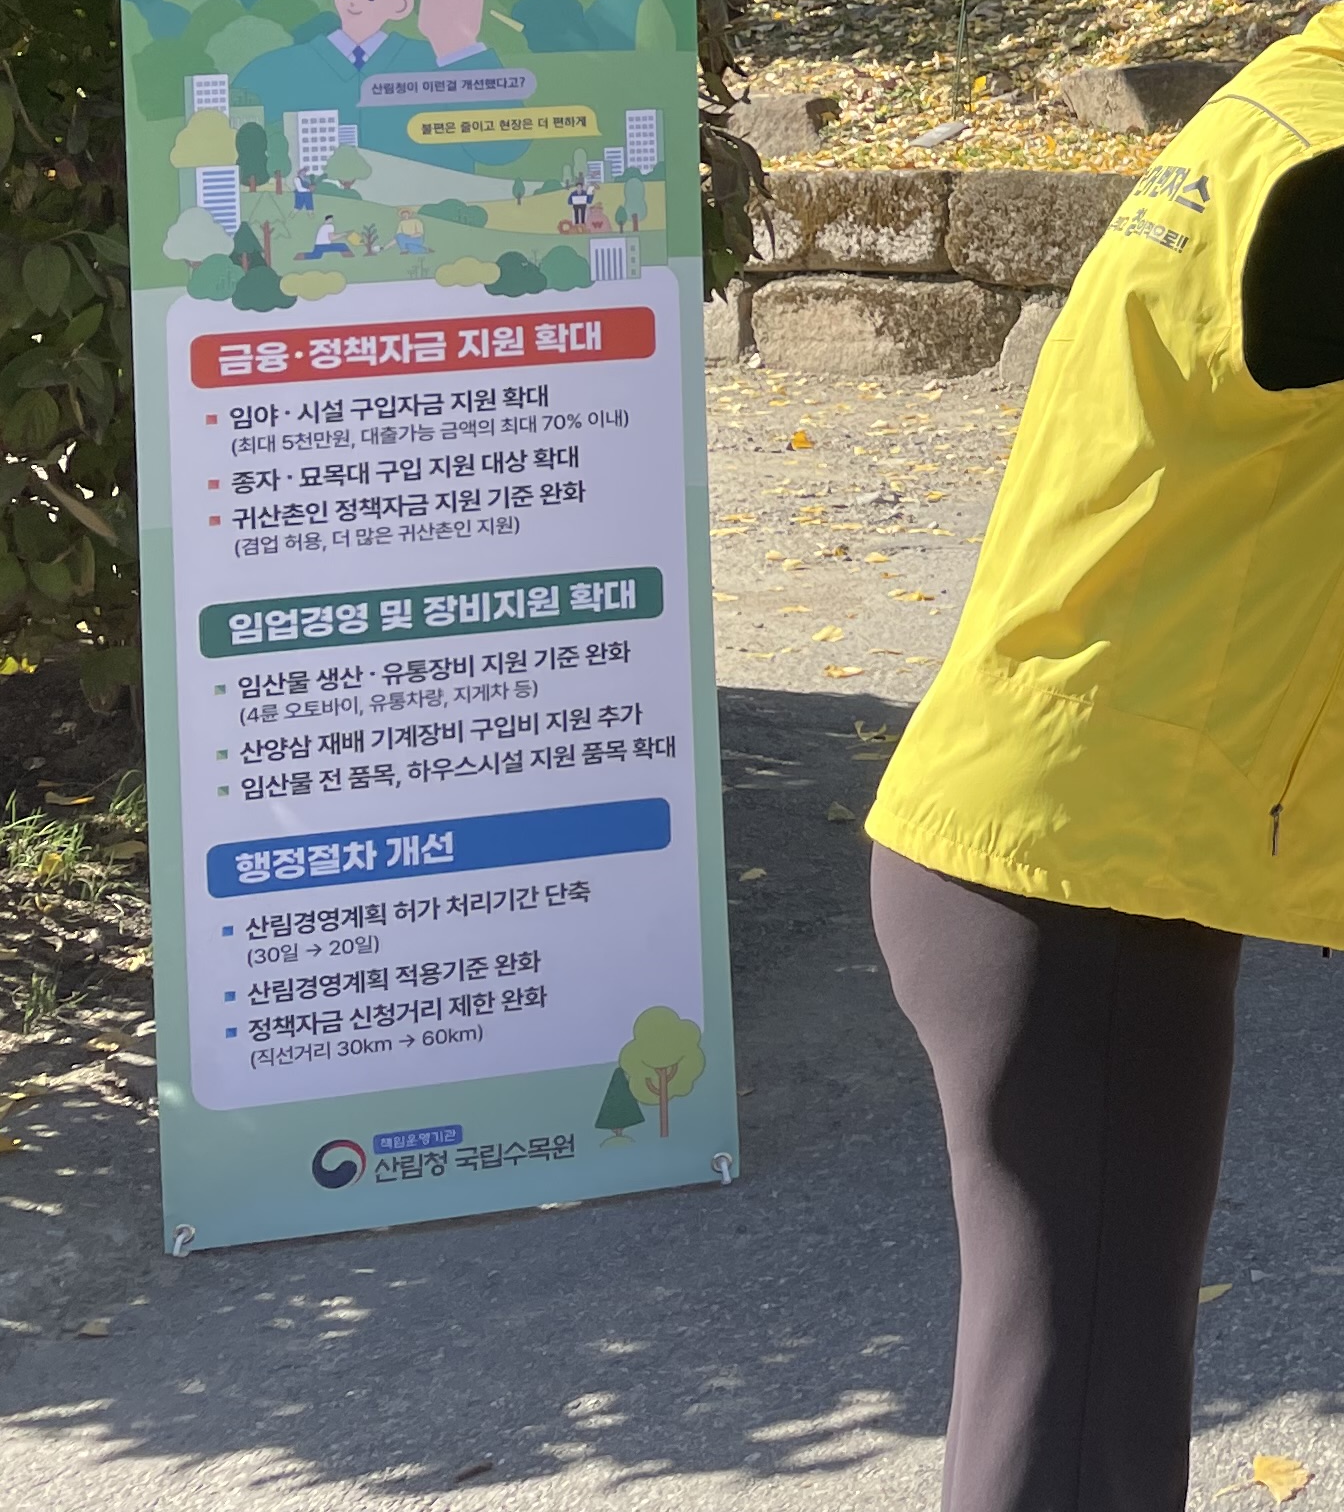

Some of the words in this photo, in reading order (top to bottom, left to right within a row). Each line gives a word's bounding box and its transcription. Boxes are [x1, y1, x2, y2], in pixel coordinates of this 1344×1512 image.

[498, 117, 534, 132] 현장은
[537, 116, 549, 130] 더
[552, 115, 587, 129] 편하게
[458, 326, 524, 358] 지원
[535, 321, 601, 353] 확대
[230, 404, 279, 430] 임야
[297, 399, 344, 424] 시설
[350, 393, 445, 421] 구입자금
[451, 388, 496, 413] 지원
[503, 384, 548, 409] 확대
[232, 434, 276, 457] (최대
[282, 429, 355, 450] 5천만원,
[361, 424, 435, 445] 대출가능
[440, 418, 495, 440] 금액의
[501, 415, 537, 435] 최대
[542, 413, 582, 431] 70%
[588, 409, 629, 428] 이내)
[231, 468, 281, 494] 종자
[299, 462, 369, 487] 묘목대
[376, 457, 421, 483] 구입
[429, 453, 475, 478] 지원
[482, 449, 528, 474] 대상
[533, 445, 579, 470] 확대
[232, 500, 328, 530] 귀산촌인
[335, 494, 429, 522] 정책자금
[435, 489, 481, 513] 지원
[488, 485, 534, 509] 기준
[540, 480, 586, 505] 완화
[235, 535, 278, 558] (겸업
[284, 532, 327, 552] 허용,
[332, 529, 350, 548] 더
[356, 526, 393, 546] 많은
[398, 519, 471, 542] 귀산촌인
[477, 516, 520, 536] 지원)
[229, 603, 368, 645] 임업경영
[380, 599, 412, 631] 및
[424, 586, 560, 626] 장비지원
[570, 579, 636, 612] 확대
[238, 671, 310, 699] 임산물
[316, 665, 364, 691] 생산
[382, 655, 474, 686] 유통장비
[482, 649, 527, 675] 지원
[535, 646, 580, 670] 기준
[585, 640, 631, 666] 완화
[284, 696, 363, 719] 오토바이,
[369, 688, 448, 713] 유통차량,
[454, 682, 510, 704] 지게차
[514, 680, 538, 698] 등)
[240, 735, 312, 764] 산양삼
[318, 729, 364, 755] 재배
[371, 720, 463, 750] 기계장비
[470, 712, 539, 741] 구입비
[546, 707, 591, 732] 지원
[597, 702, 643, 728] 추가
[241, 771, 313, 800] 임산물
[319, 768, 342, 792] 전
[348, 764, 401, 789] 품목,
[407, 749, 523, 783] 하우스시설
[530, 744, 575, 770] 지원
[581, 740, 627, 765] 품목
[633, 735, 676, 760] 확대
[235, 840, 377, 883] 행정절차
[386, 831, 454, 867] 개선
[246, 902, 386, 940] 산림경영계획
[393, 897, 441, 923] 허가
[446, 885, 540, 917] 처리기간
[545, 881, 591, 907] 단축
[247, 943, 298, 968] (30일
[329, 935, 379, 956] 20일)
[248, 967, 388, 1006] 산림경영계획
[396, 956, 489, 987] 적용기준
[494, 950, 541, 977] 완화
[249, 1010, 343, 1042] 정책자금
[349, 997, 442, 1030] 신청거리
[449, 991, 495, 1017] 제한
[501, 985, 547, 1012] 완화
[251, 1041, 331, 1070] (직선거리
[337, 1038, 392, 1057] 30km
[422, 1024, 483, 1046] 60km)
[375, 1150, 447, 1183] 산림청
[455, 1133, 575, 1171] 국립수목원
[380, 1129, 456, 1149] 책임운영기관
